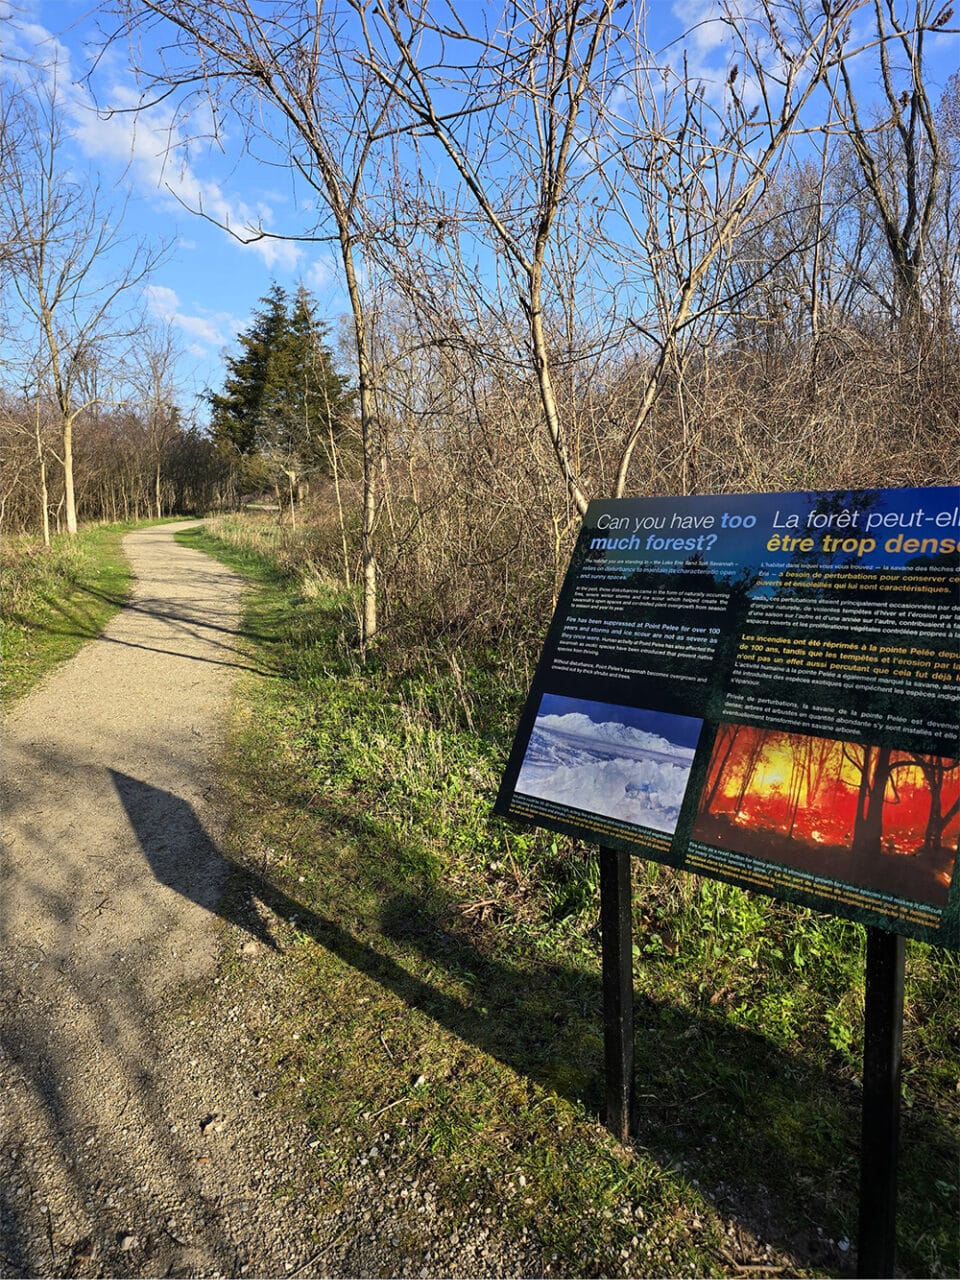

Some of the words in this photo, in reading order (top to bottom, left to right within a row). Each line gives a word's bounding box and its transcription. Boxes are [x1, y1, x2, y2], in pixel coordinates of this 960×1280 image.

[597, 513, 630, 530] Can
[633, 517, 667, 533] you
[670, 513, 715, 529] have
[721, 512, 757, 529] too
[772, 510, 800, 528] La
[806, 508, 860, 528] forêt
[590, 534, 640, 550] much
[645, 533, 718, 551] forest?
[766, 533, 815, 552] être
[822, 534, 877, 557] trop
[785, 569, 811, 578] besoin
[840, 653, 878, 662] tempêtes
[910, 648, 935, 656] Pelée
[830, 664, 870, 672] percutant
[932, 673, 952, 681] déjà
